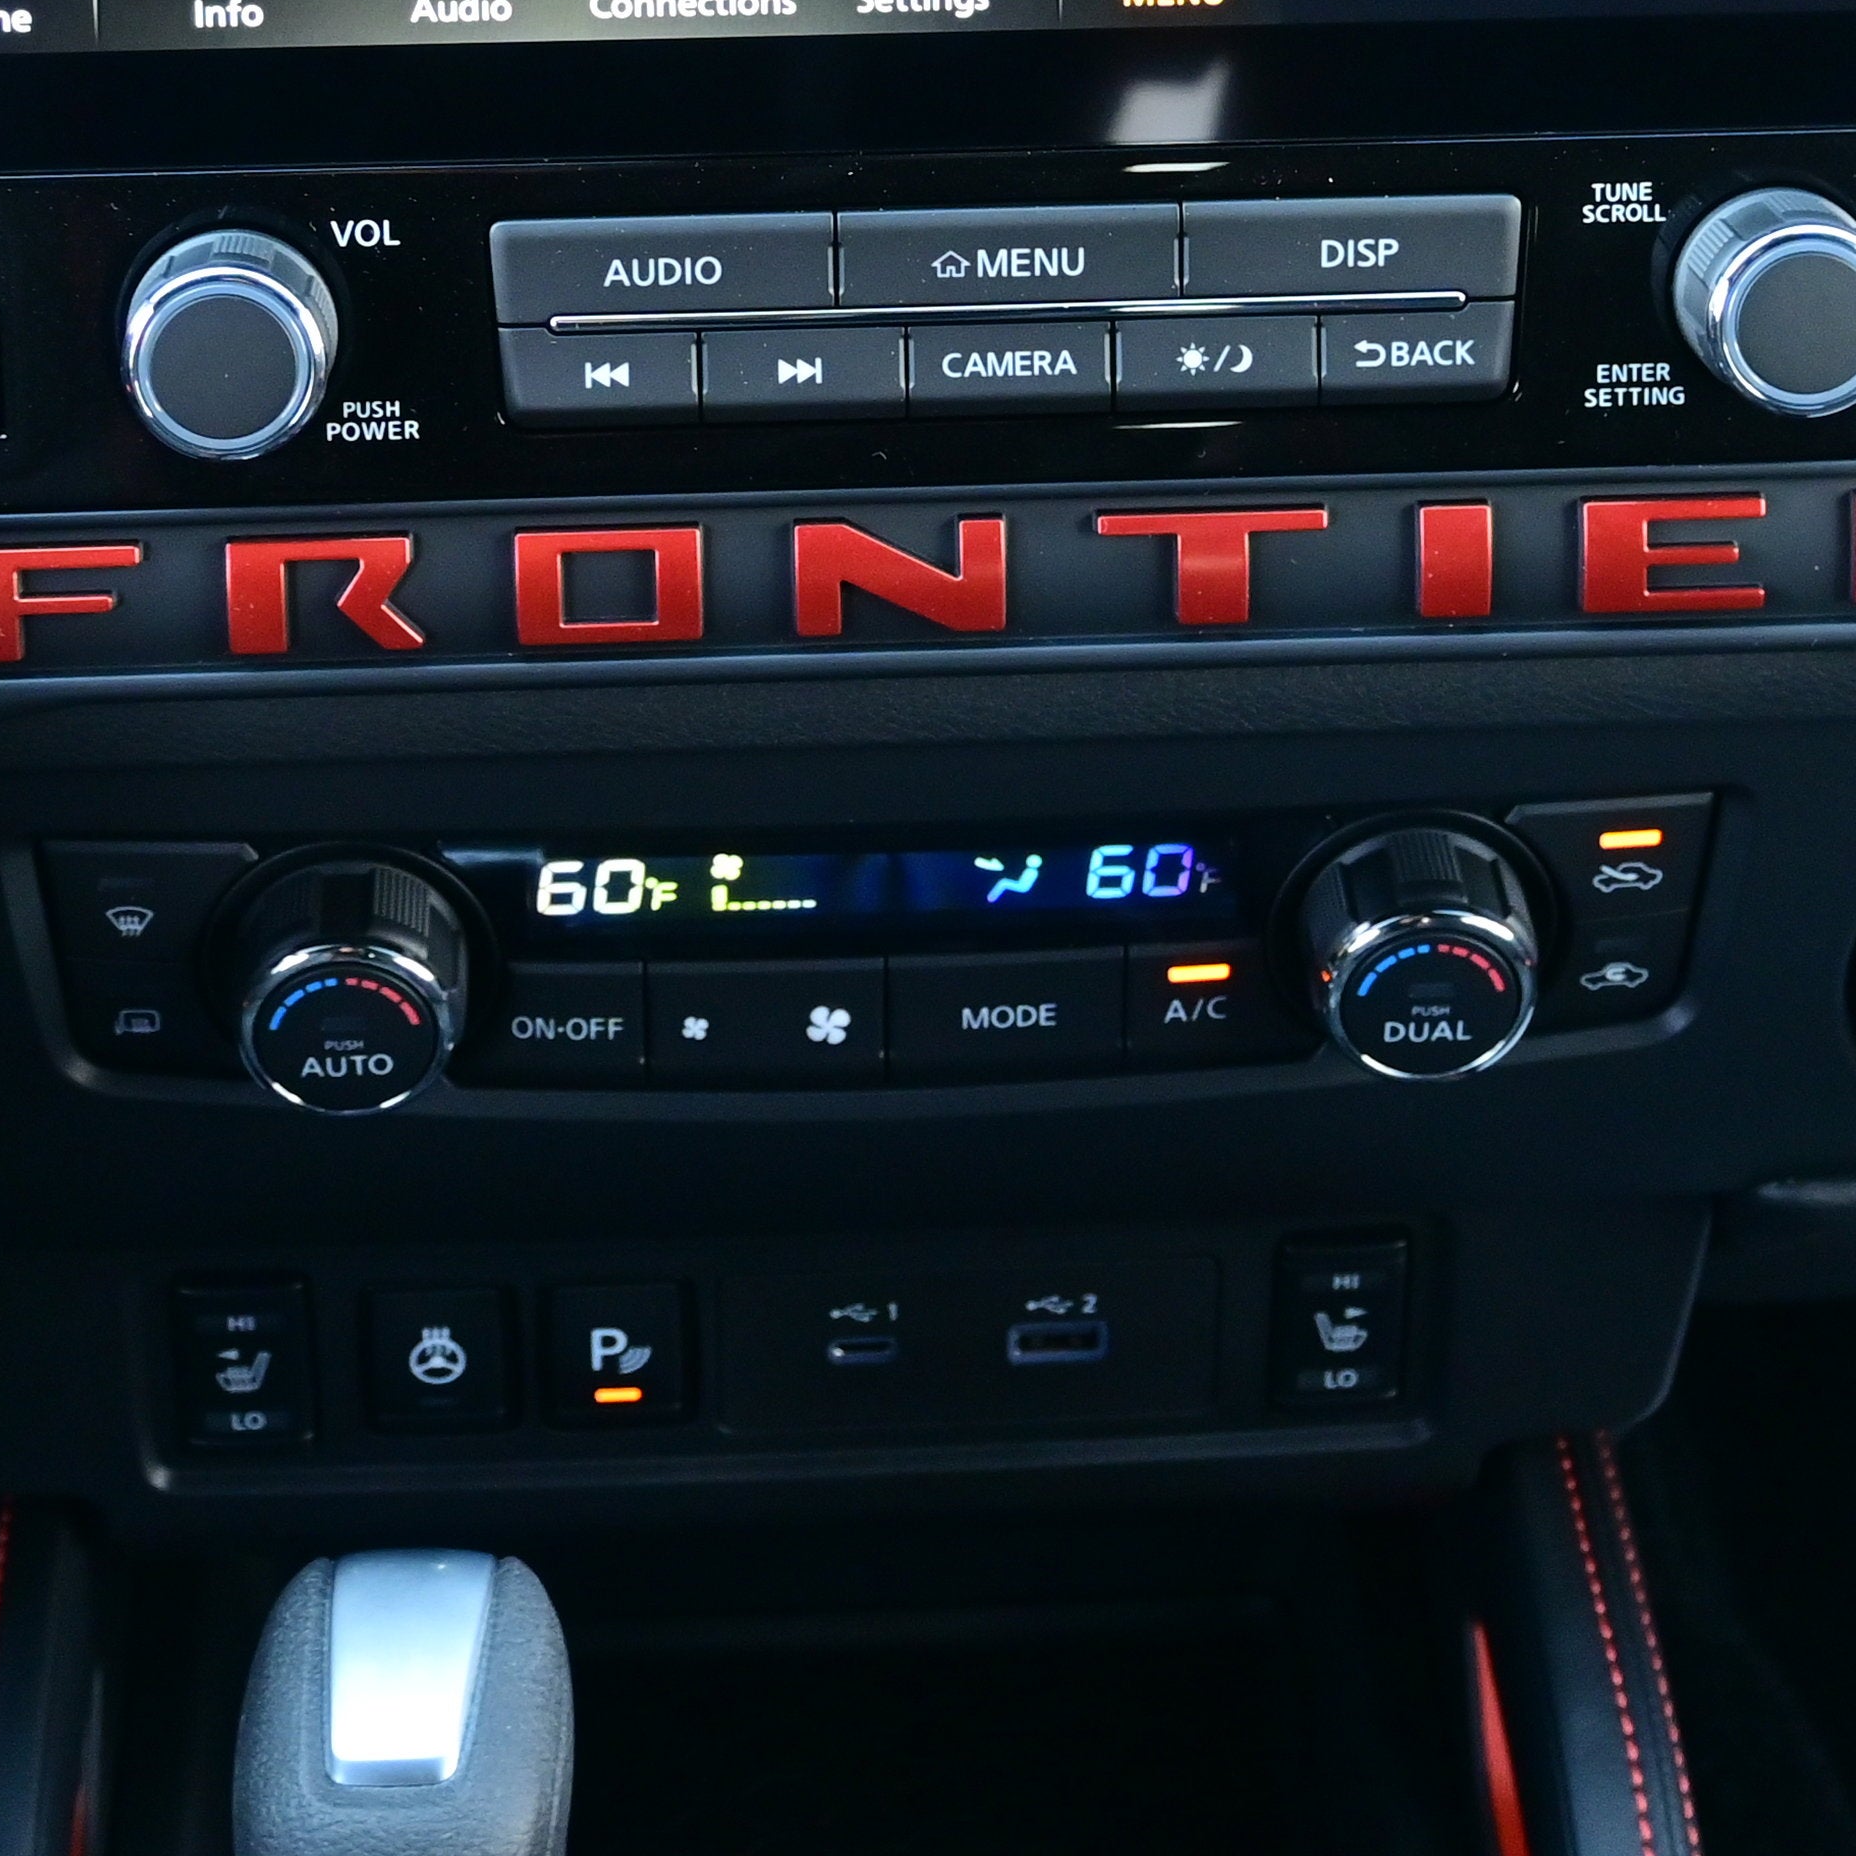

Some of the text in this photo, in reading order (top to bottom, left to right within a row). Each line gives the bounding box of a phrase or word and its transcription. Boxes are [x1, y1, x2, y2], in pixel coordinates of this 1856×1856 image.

[1591, 181, 1654, 203] TUNE
[1582, 202, 1667, 224] SCROLL
[330, 219, 402, 248] VOL
[976, 247, 1086, 279] MENU
[1320, 237, 1400, 268] DISP
[603, 256, 723, 288] AUDIO
[942, 349, 1078, 380] CAMERA
[1391, 340, 1476, 368] BACK
[1596, 362, 1671, 383] ENTER
[1584, 385, 1686, 408] SETTING
[342, 400, 402, 420] PUSH
[325, 419, 421, 443] POWER
[961, 1002, 1058, 1030] MODE
[1163, 996, 1228, 1025] A/C
[1411, 1005, 1451, 1017] PUSH
[1383, 1019, 1473, 1044] DUAL
[323, 1039, 365, 1051] PUSH
[300, 1053, 395, 1079] AUTO
[1331, 1273, 1361, 1291] HI
[226, 1315, 257, 1333] HI
[589, 1327, 629, 1372] P
[1323, 1369, 1360, 1390] LO
[230, 1410, 268, 1432] LO
